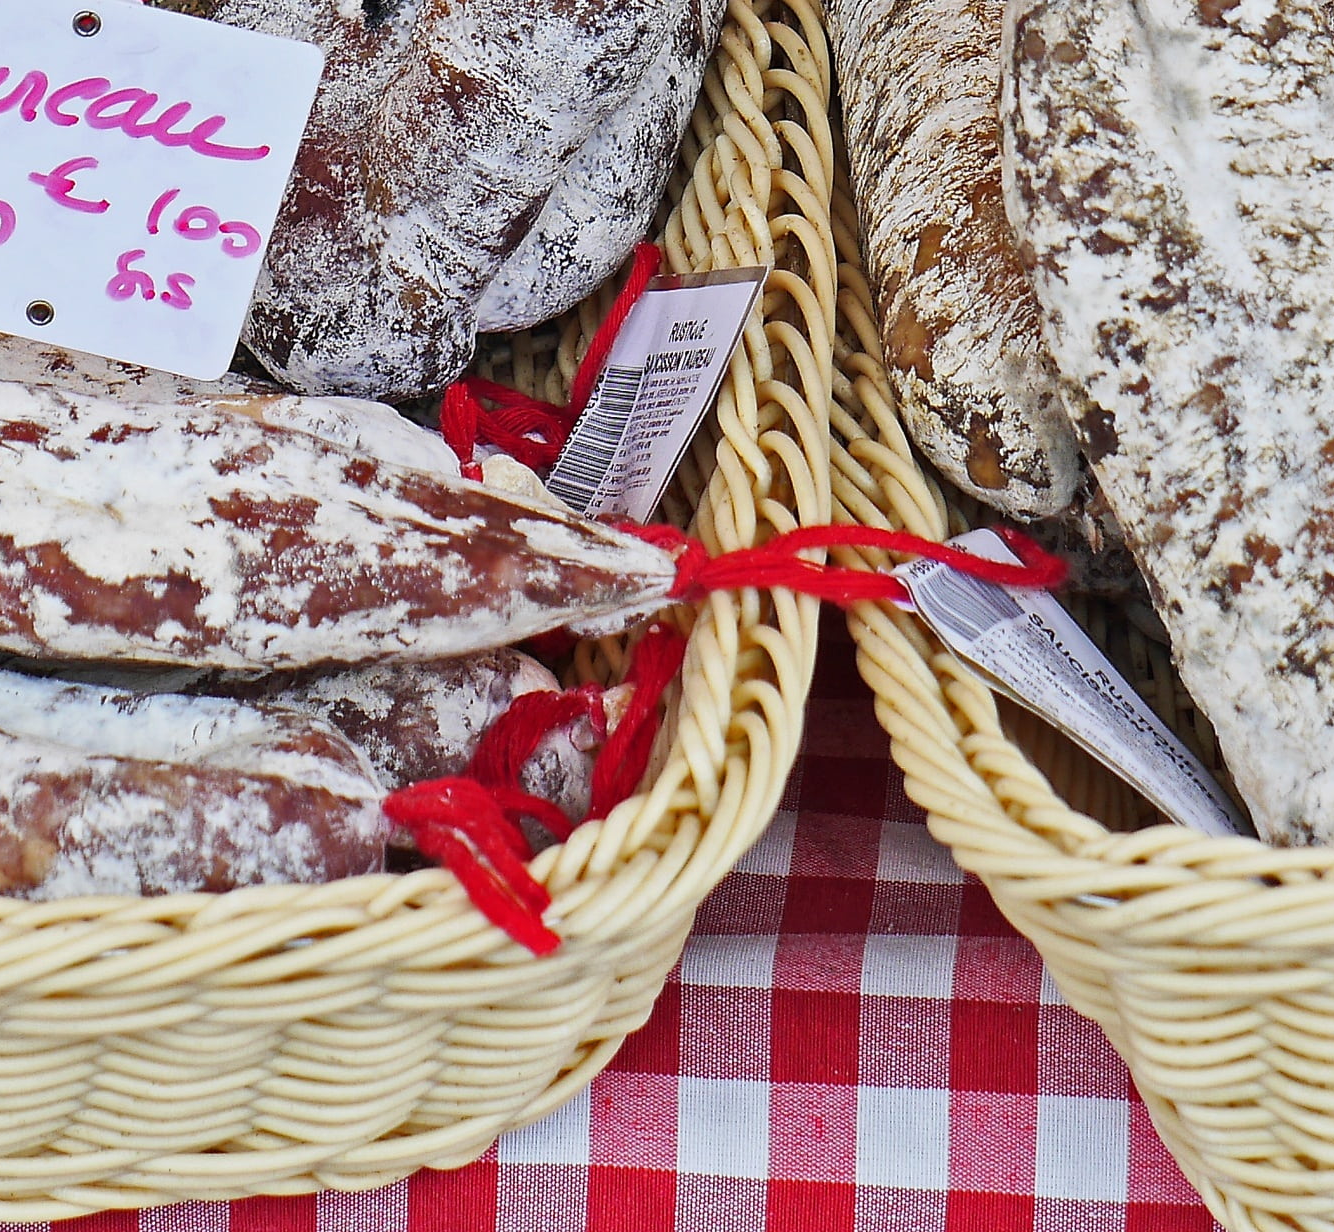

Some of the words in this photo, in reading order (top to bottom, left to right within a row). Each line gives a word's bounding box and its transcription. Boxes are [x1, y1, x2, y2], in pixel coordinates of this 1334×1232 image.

[29, 156, 111, 214] €
[147, 188, 262, 258] 100
[1028, 612, 1146, 733] SAUCISSON
[1095, 669, 1195, 771] RUSTIQUE
